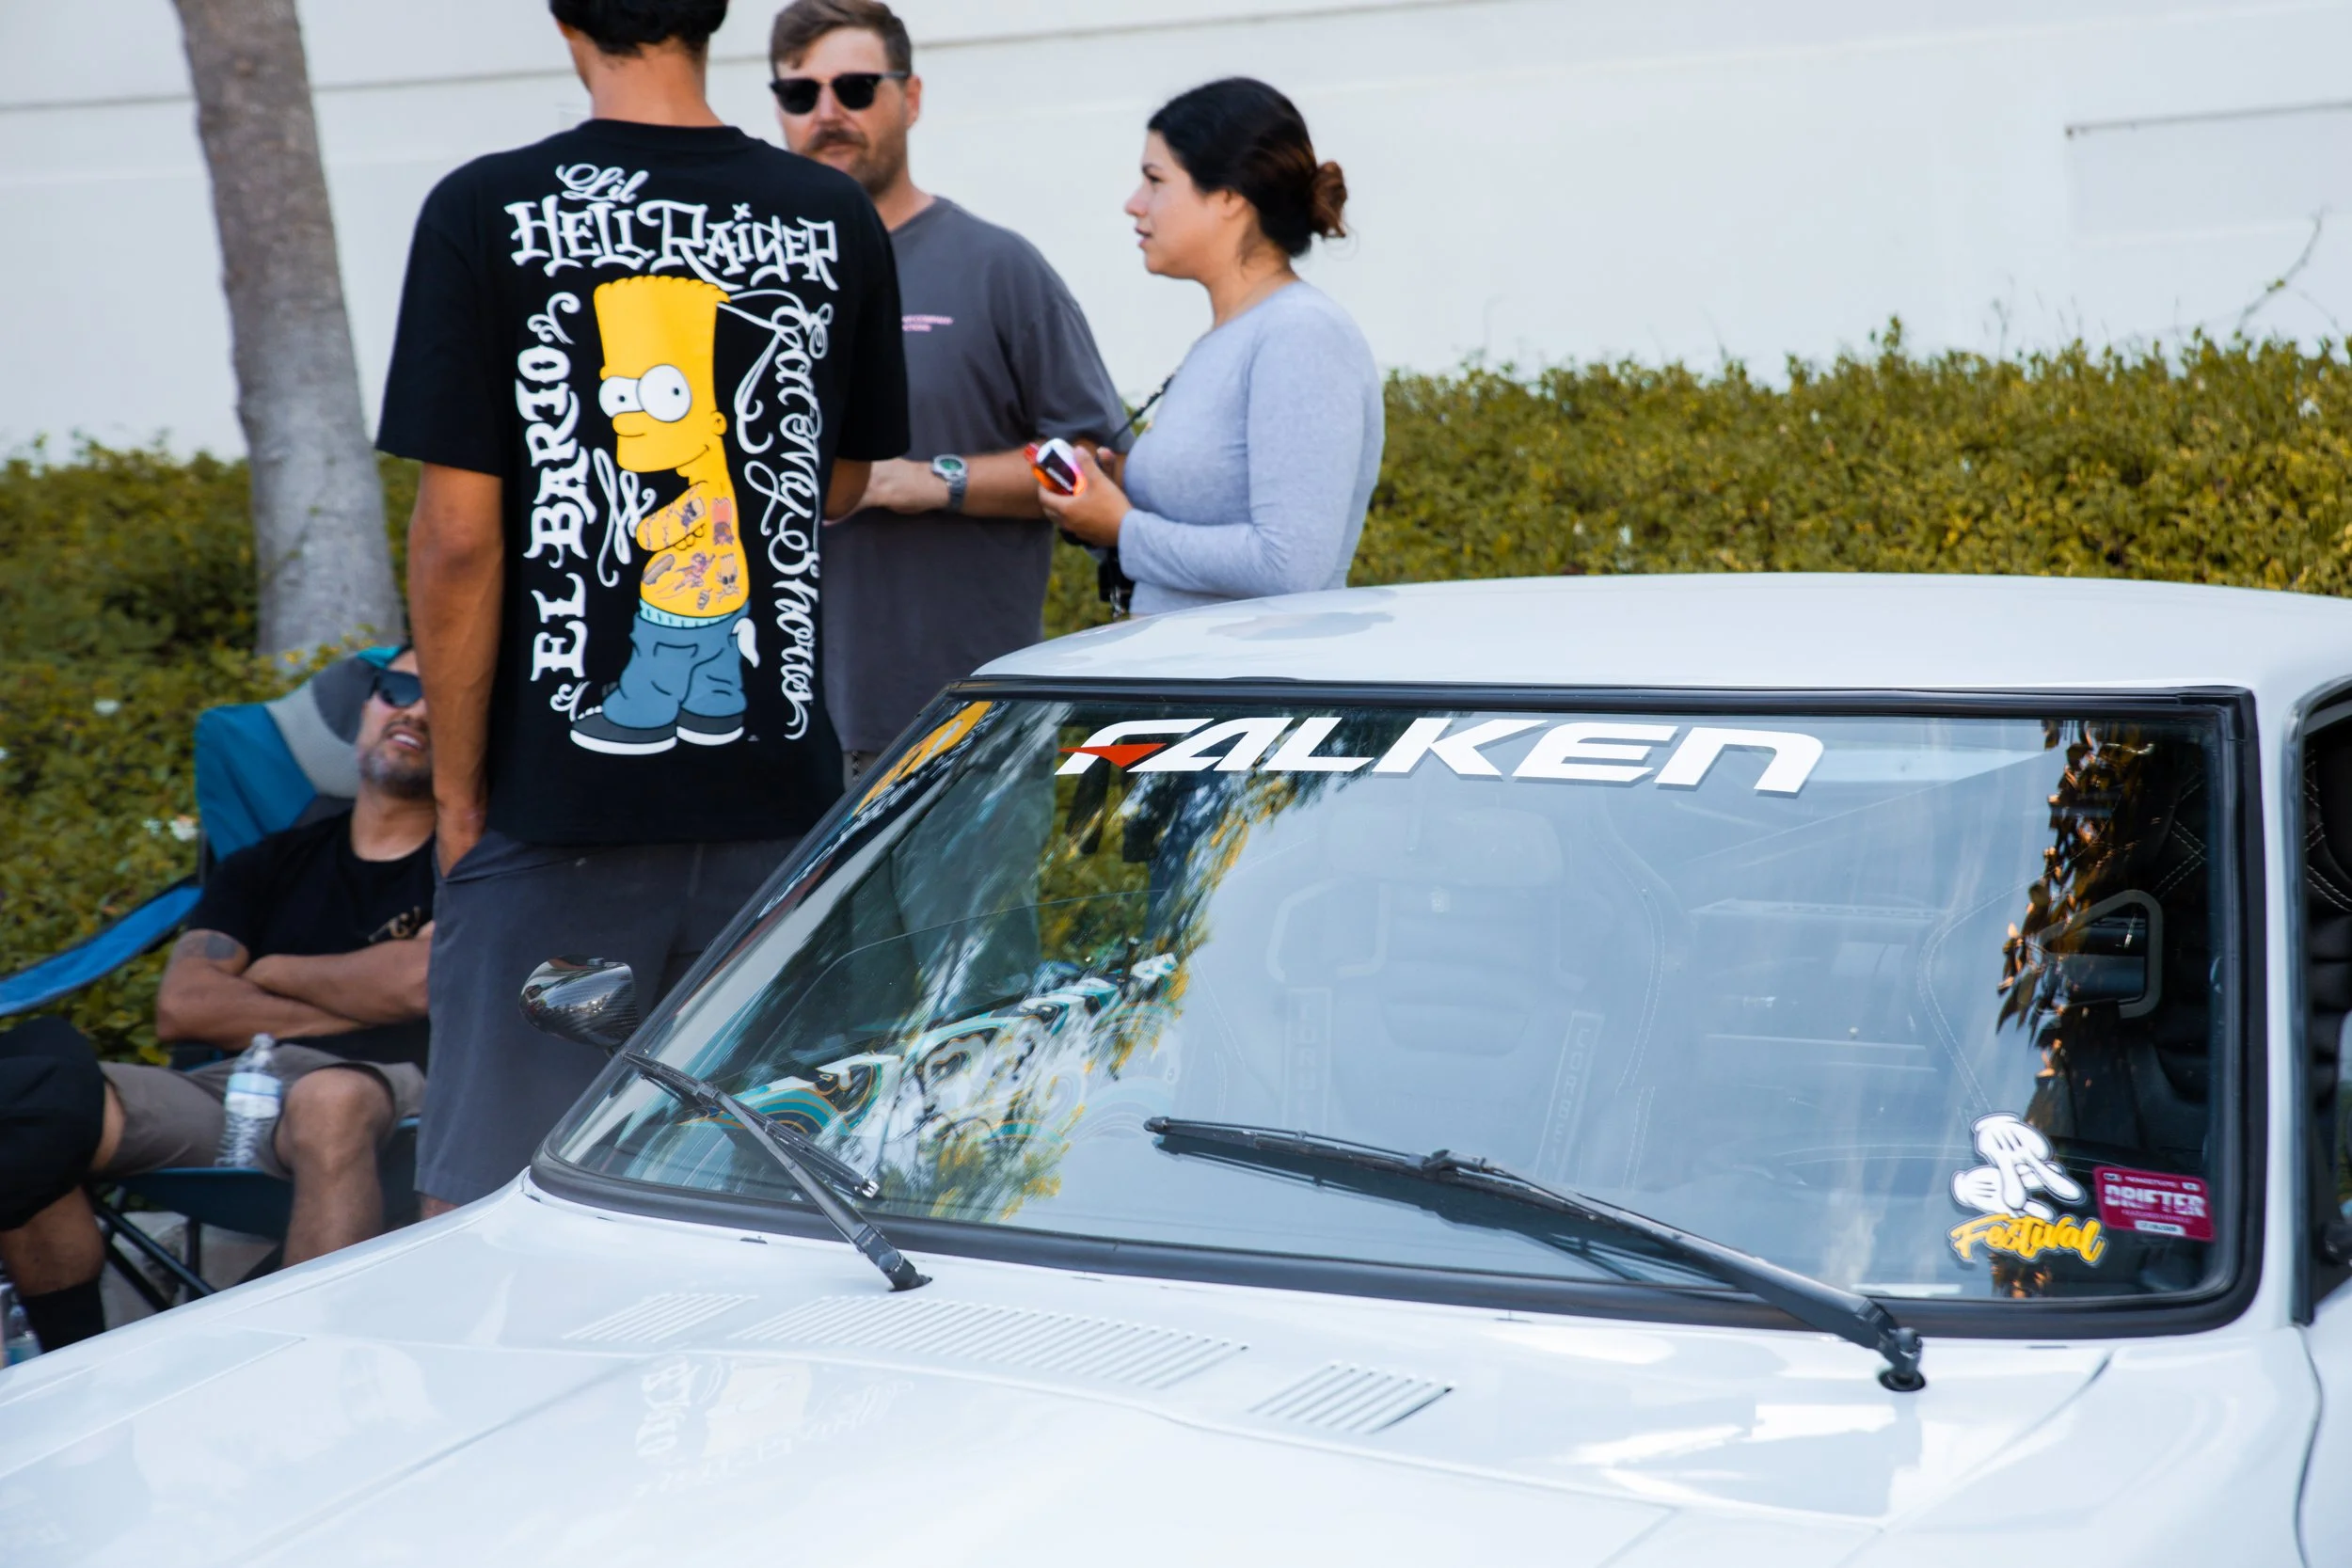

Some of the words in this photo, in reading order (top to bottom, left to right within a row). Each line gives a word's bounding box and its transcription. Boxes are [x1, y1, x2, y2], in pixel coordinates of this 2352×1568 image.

[555, 163, 649, 203] Lil
[530, 572, 588, 682] EL
[1055, 716, 1825, 795] FALKEN
[2104, 1184, 2207, 1218] DRIFTER
